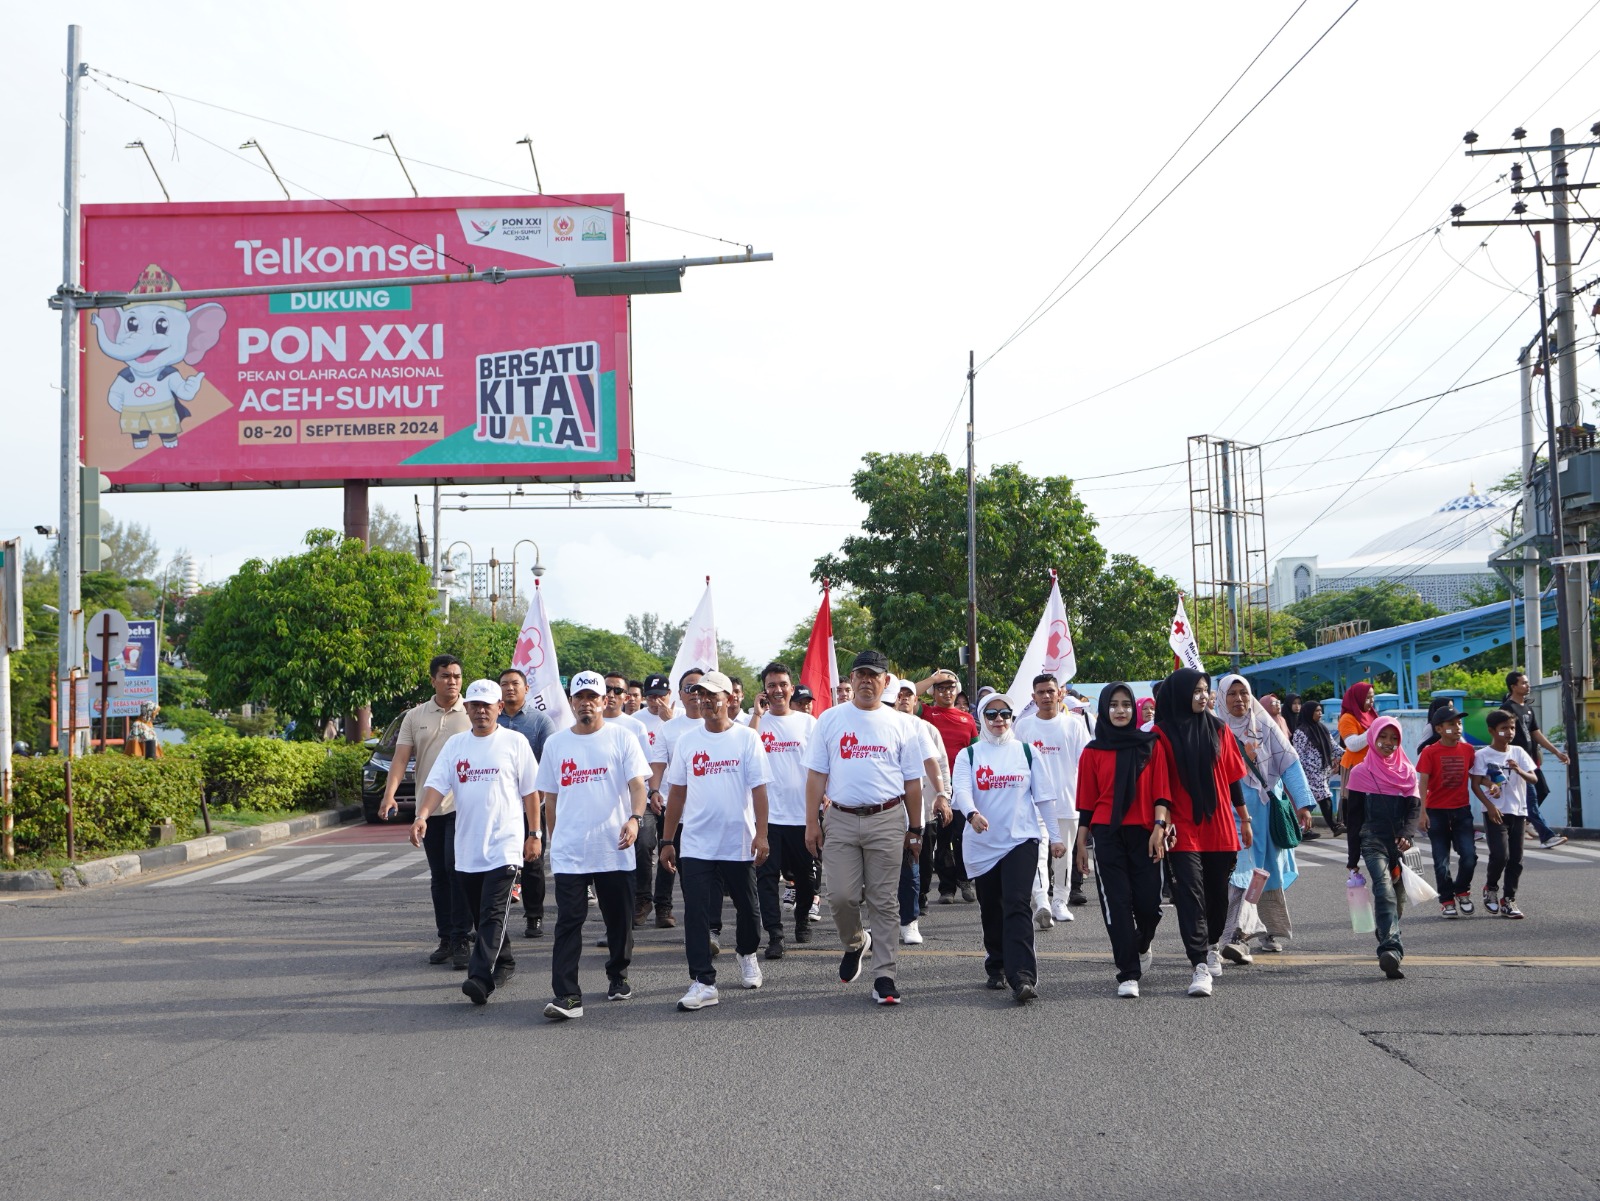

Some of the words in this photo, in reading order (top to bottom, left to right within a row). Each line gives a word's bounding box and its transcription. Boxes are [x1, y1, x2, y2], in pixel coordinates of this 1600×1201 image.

[502, 218, 524, 226] PON
[525, 217, 542, 226] XXI
[234, 233, 446, 275] Telkomsel
[290, 290, 390, 310] DUKUNG
[238, 325, 347, 364] PON
[359, 323, 444, 361] XXI
[479, 344, 594, 380] BERSATU
[238, 370, 286, 382] PEKAN
[288, 367, 368, 381] OLAHRAGA
[371, 366, 444, 379] NASIONAL
[238, 384, 444, 412] ACEH-SUMUT
[243, 425, 293, 439] 08-20
[305, 423, 396, 437] SEPTEMBER
[399, 421, 439, 434] 2024
[576, 677, 599, 687] Aceh
[650, 678, 660, 688] F
[852, 744, 888, 753] HUMANITY
[851, 751, 870, 759] FEST
[705, 759, 740, 768] HUMANITY
[572, 767, 608, 777] HUMANITY
[705, 767, 722, 775] FEST
[572, 776, 590, 785] FEST
[990, 774, 1025, 783] HUMANITY
[990, 781, 1007, 789] FEST
